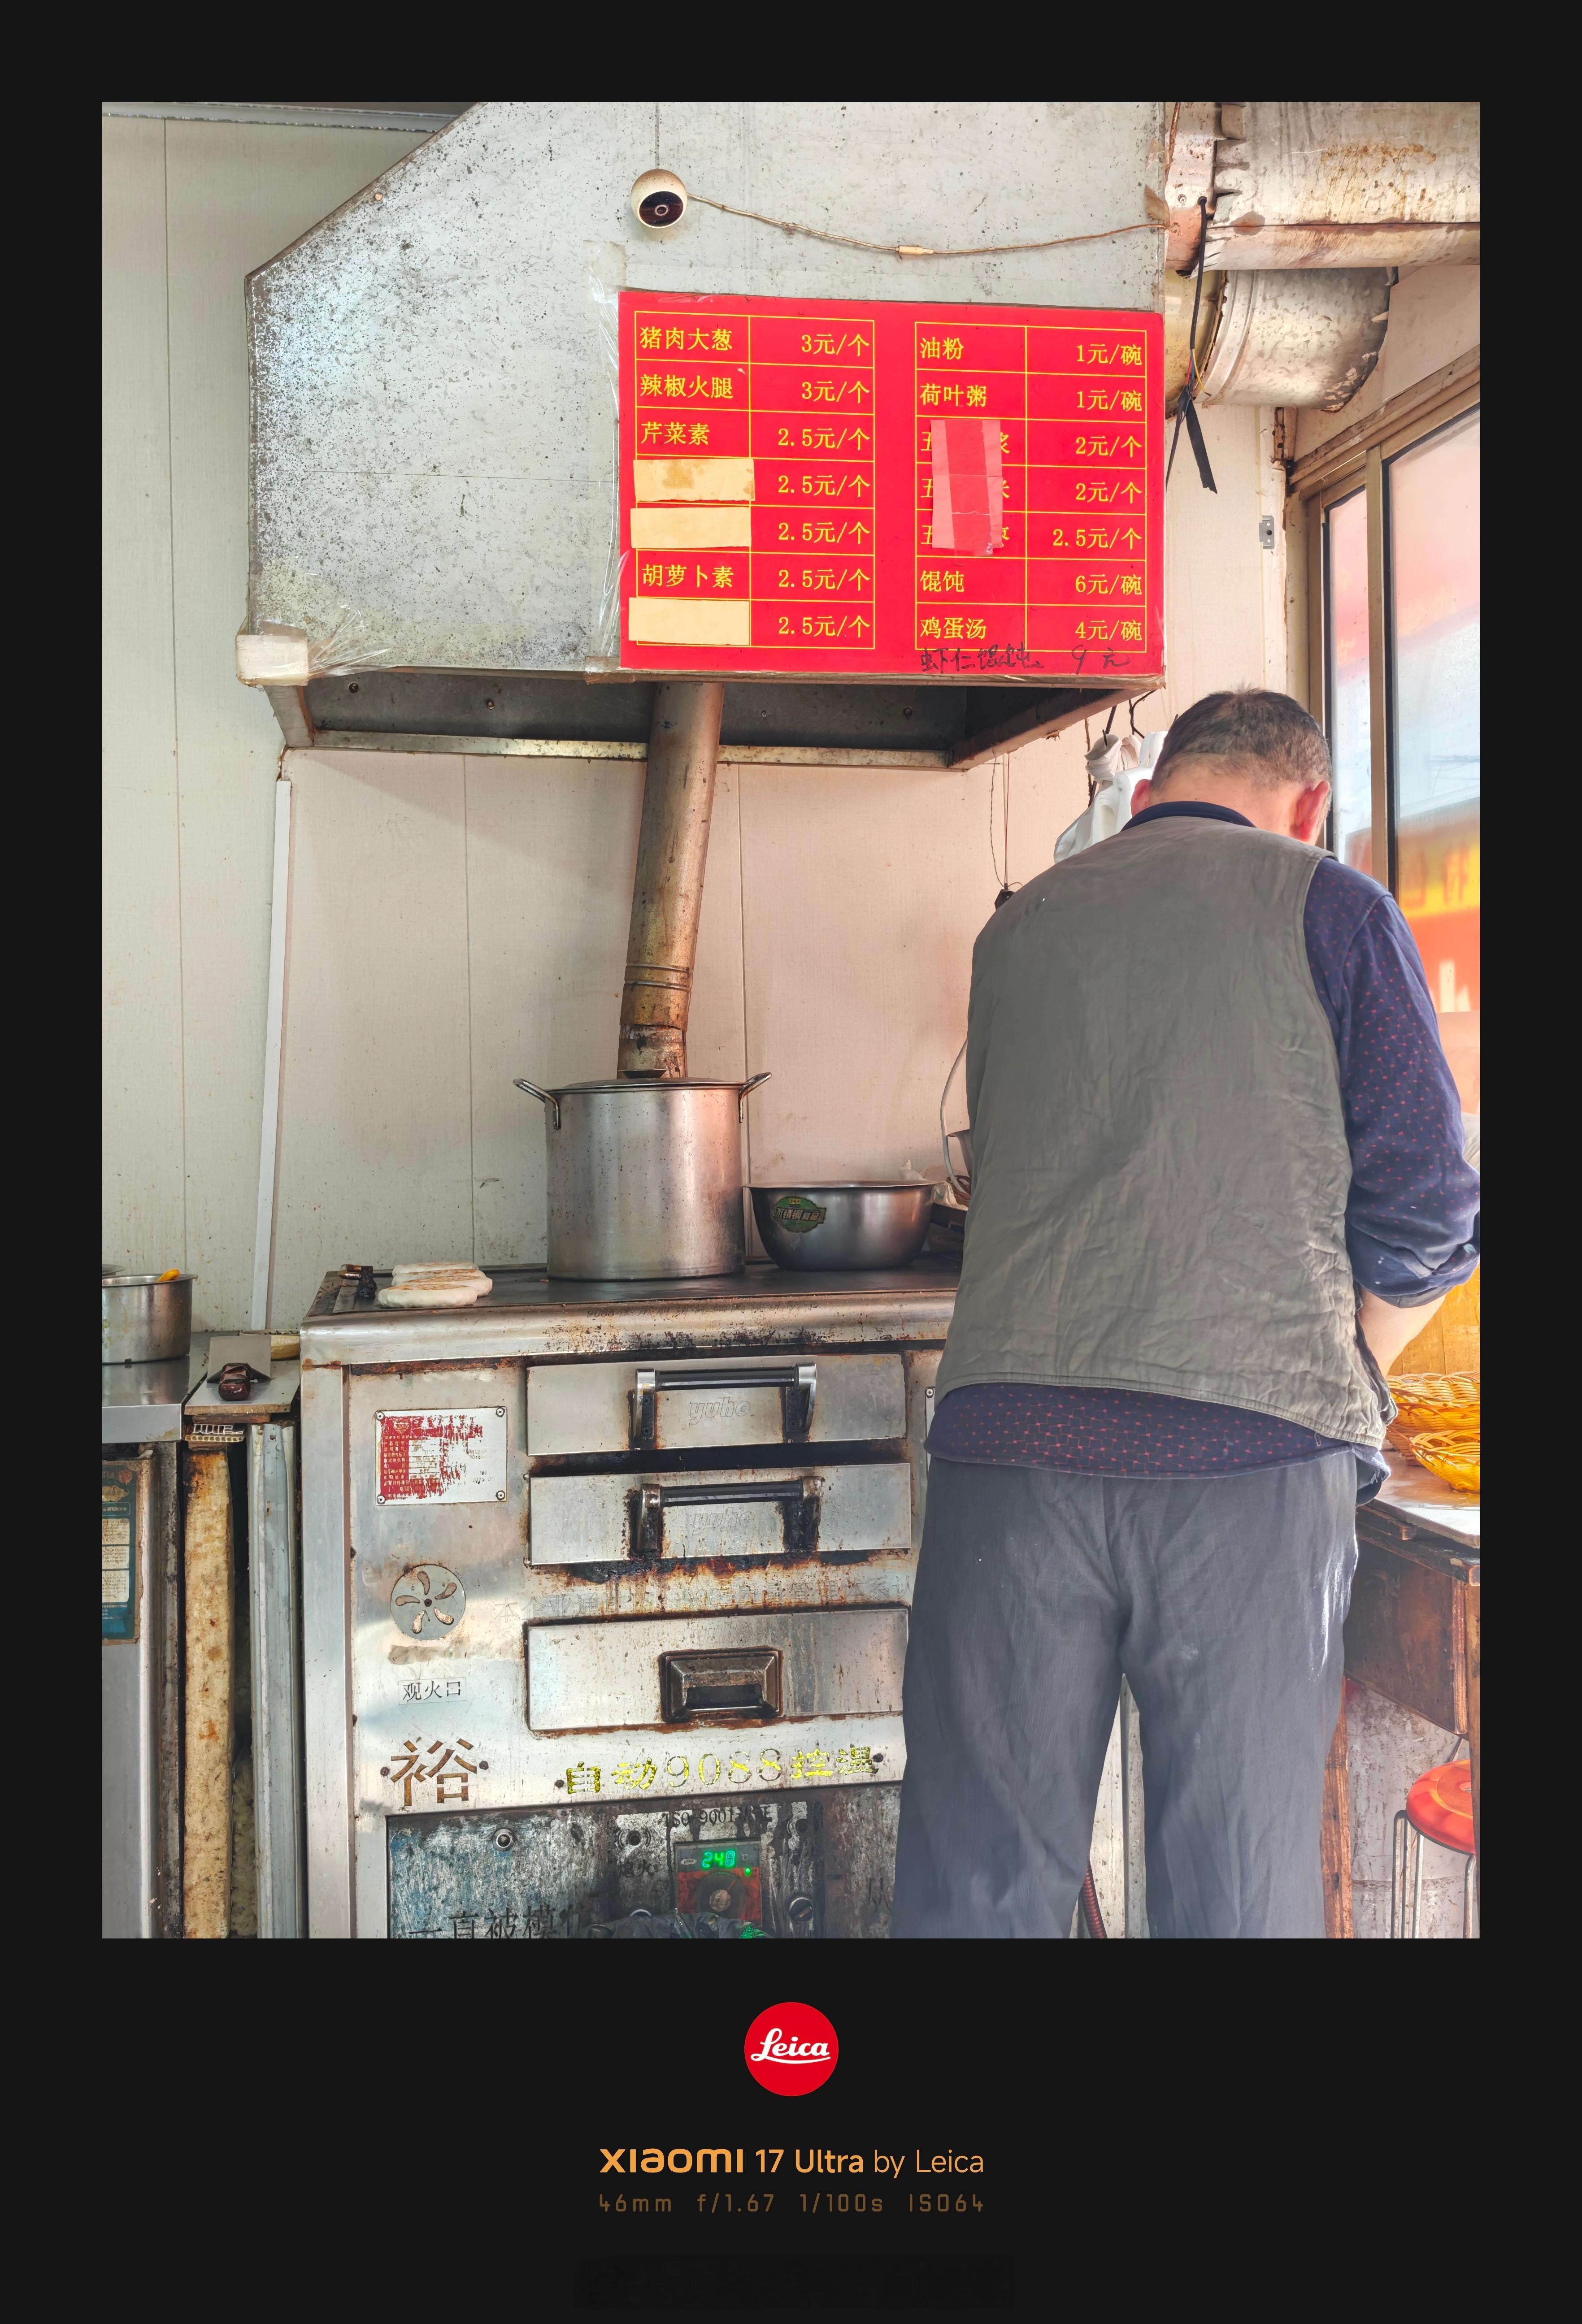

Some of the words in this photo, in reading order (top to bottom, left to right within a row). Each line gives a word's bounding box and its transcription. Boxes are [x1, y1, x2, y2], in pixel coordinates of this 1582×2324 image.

[639, 326, 732, 351] 猪肉大葱
[801, 334, 870, 357] 3元/个
[920, 337, 964, 360] 油粉
[1077, 343, 1142, 366] 1元/碗
[640, 373, 733, 399] 辣椒火腿
[802, 381, 870, 403] 3元/个
[920, 383, 987, 407] 荷叶粥
[1077, 390, 1142, 412] 1元/碗
[641, 421, 710, 445] 芹菜素
[778, 427, 870, 451] 2.5元/个
[1076, 435, 1142, 458] 2元/个
[778, 474, 870, 498] 2.5元/个
[1076, 481, 1142, 504] 2元/个
[778, 521, 870, 544] 2.5元/个
[1052, 527, 1142, 550] 2.5元/个
[642, 564, 734, 588] 胡萝卜素
[778, 568, 870, 591] 2.5元/个
[920, 570, 965, 592] 馄饨
[1075, 573, 1142, 596] 6元/碗
[778, 615, 870, 638] 2.5元/个
[920, 616, 987, 639] 鸡蛋汤
[1075, 619, 1142, 642] 4元/碗
[689, 1396, 751, 1427] yuhe
[402, 1680, 461, 1703] 观火口
[390, 1738, 477, 1806] 裕
